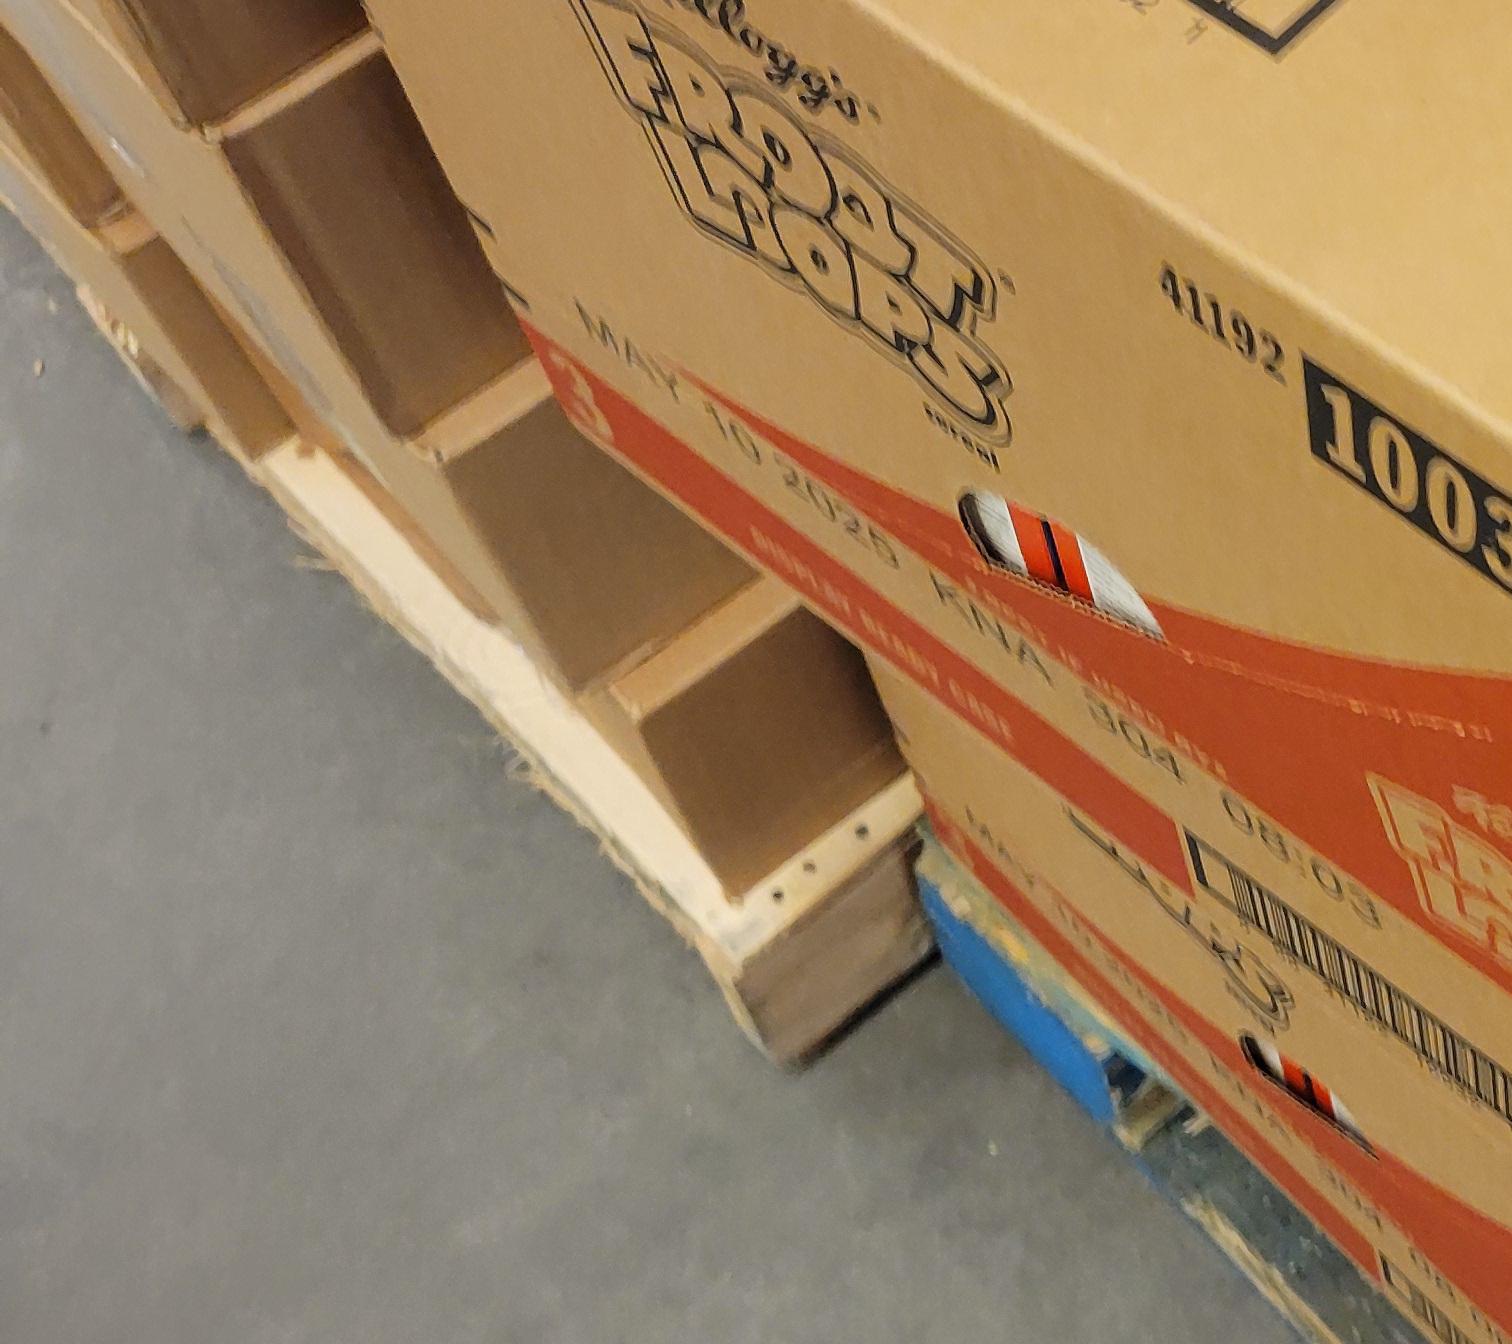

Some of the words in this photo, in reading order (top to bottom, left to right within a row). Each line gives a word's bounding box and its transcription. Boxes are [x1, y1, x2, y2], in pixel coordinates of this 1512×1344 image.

[643, 111, 1013, 452] LOOPS
[1156, 260, 1289, 387] 41192
[572, 295, 681, 405] MAY
[702, 399, 762, 466] 10
[927, 567, 1054, 688] KNA
